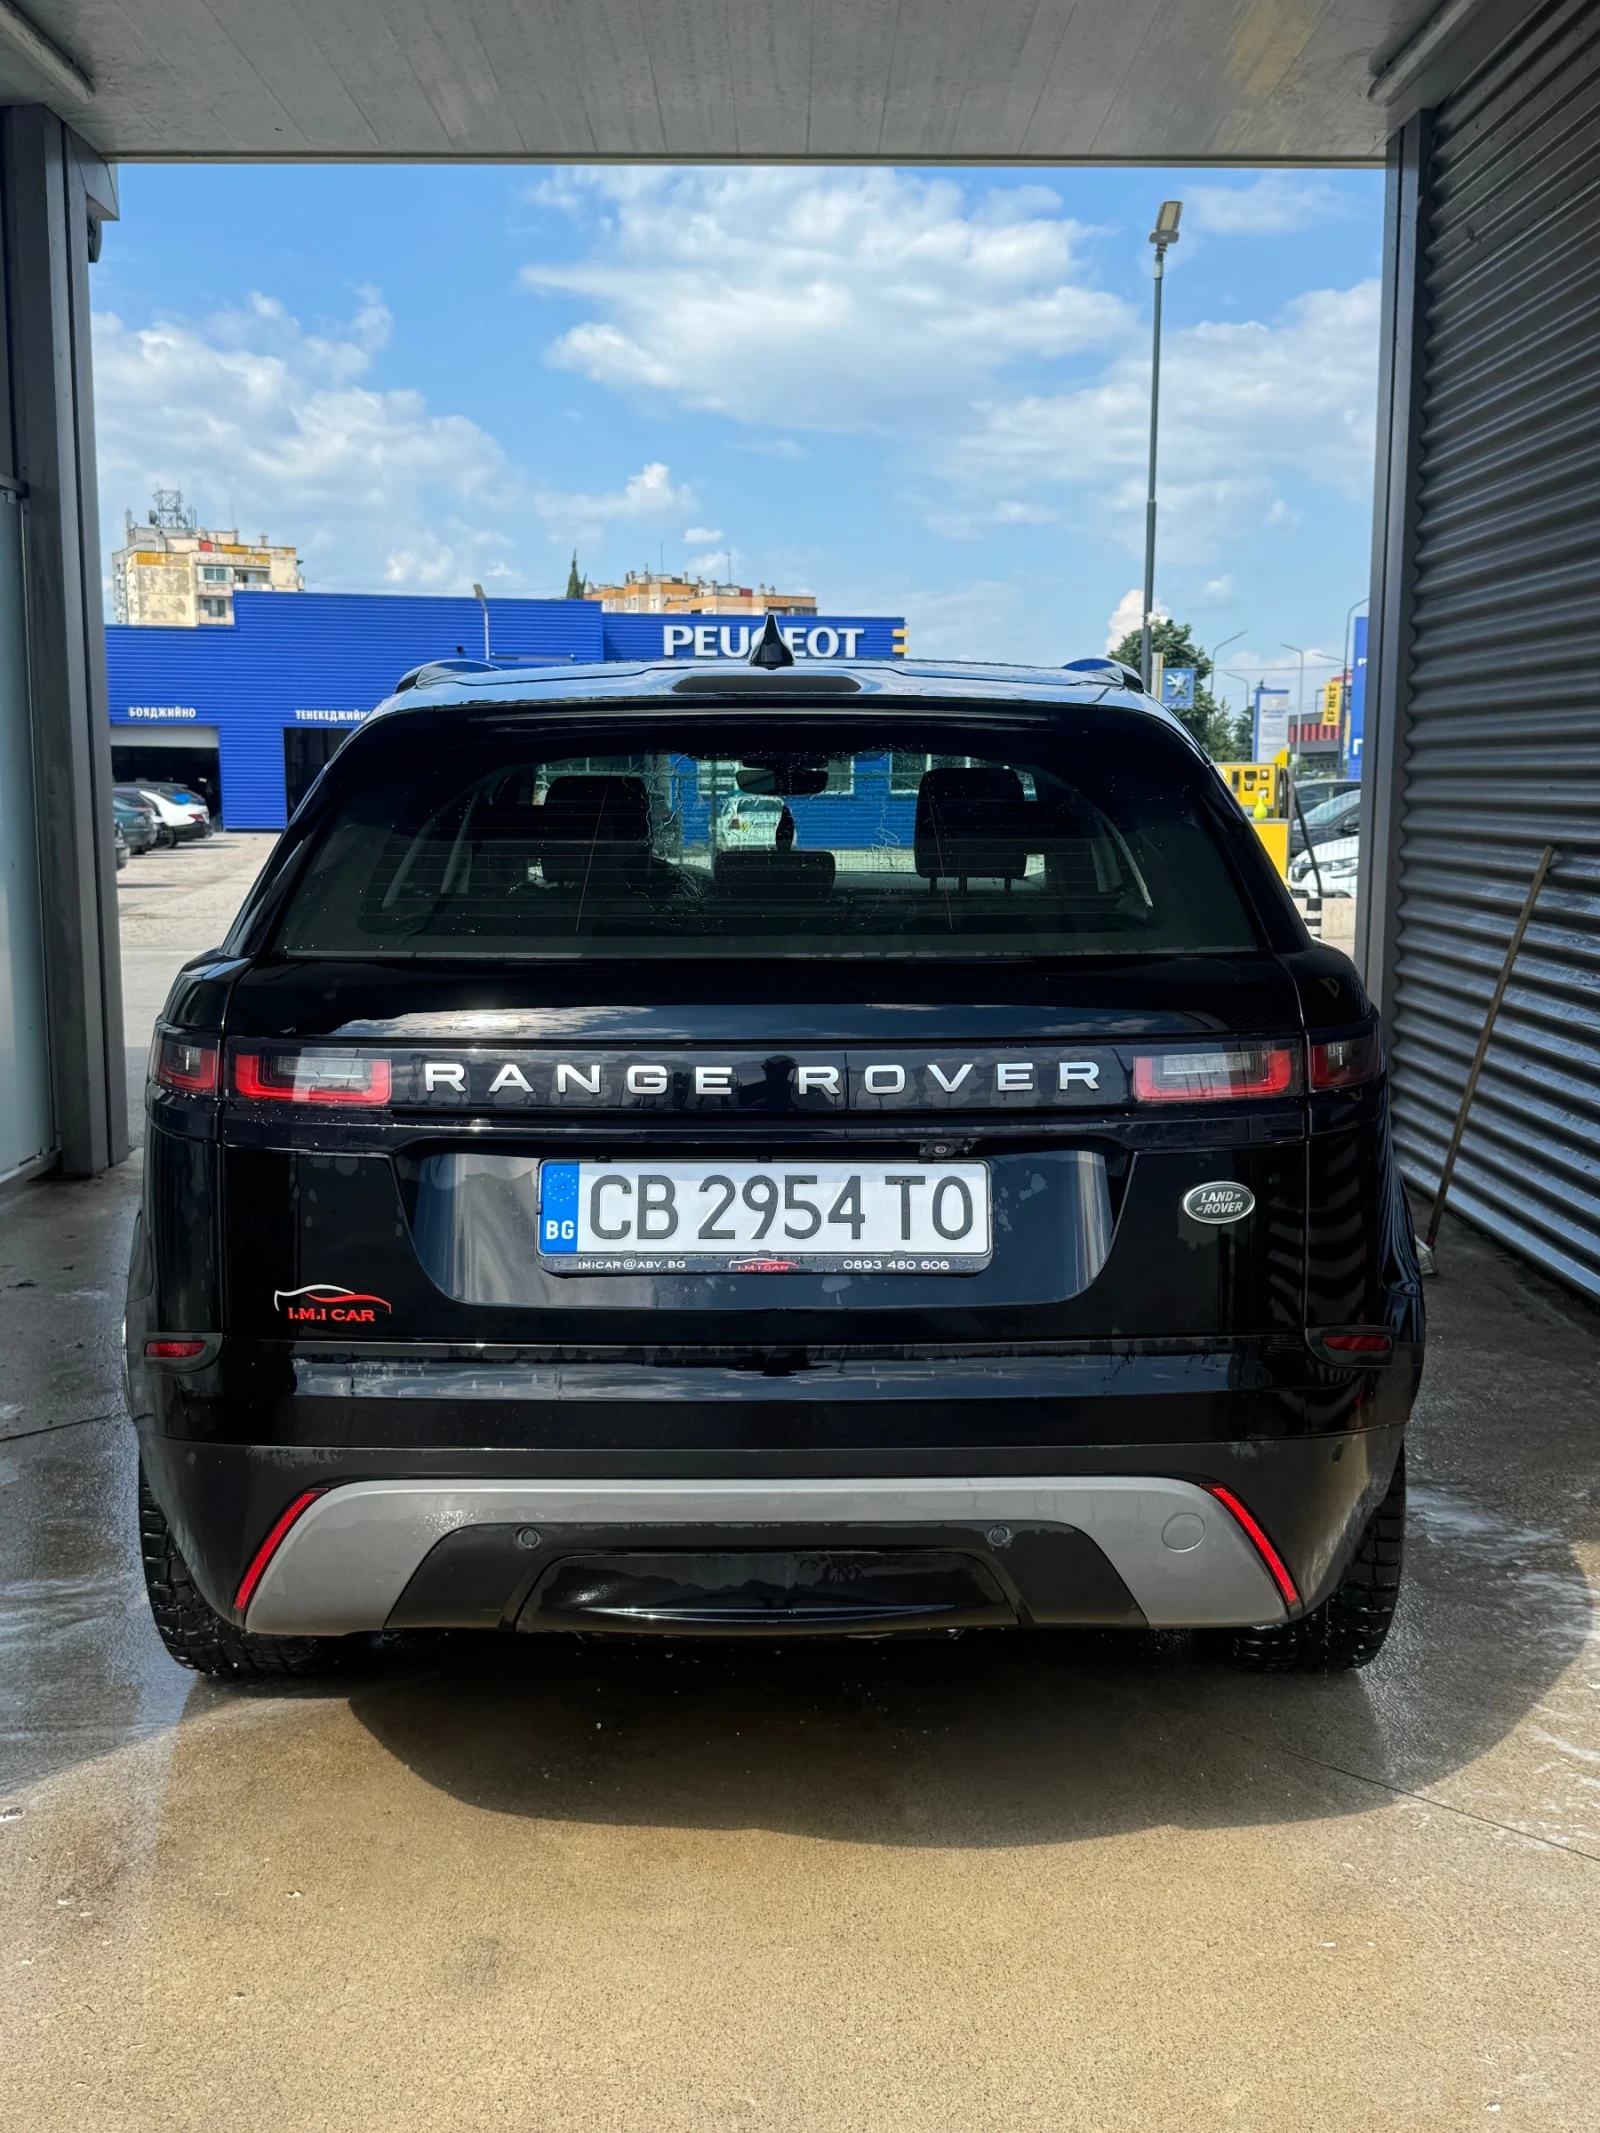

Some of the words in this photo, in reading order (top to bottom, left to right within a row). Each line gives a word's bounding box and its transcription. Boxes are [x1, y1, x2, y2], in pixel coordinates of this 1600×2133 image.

[128, 706, 197, 719] БОЯДЖИЙНО
[424, 1063, 733, 1095] RANGE
[798, 1062, 1100, 1095] ROVER
[1201, 1191, 1233, 1203] LAND
[589, 1175, 678, 1240] CB
[697, 1175, 866, 1240] 2954
[1203, 1202, 1243, 1214] ROVER
[546, 1220, 575, 1240] BG
[843, 1260, 882, 1270] 0893
[887, 1260, 916, 1270] 480
[921, 1260, 950, 1270] 606
[288, 1307, 327, 1321] I.M.I
[331, 1309, 375, 1322] CAR
